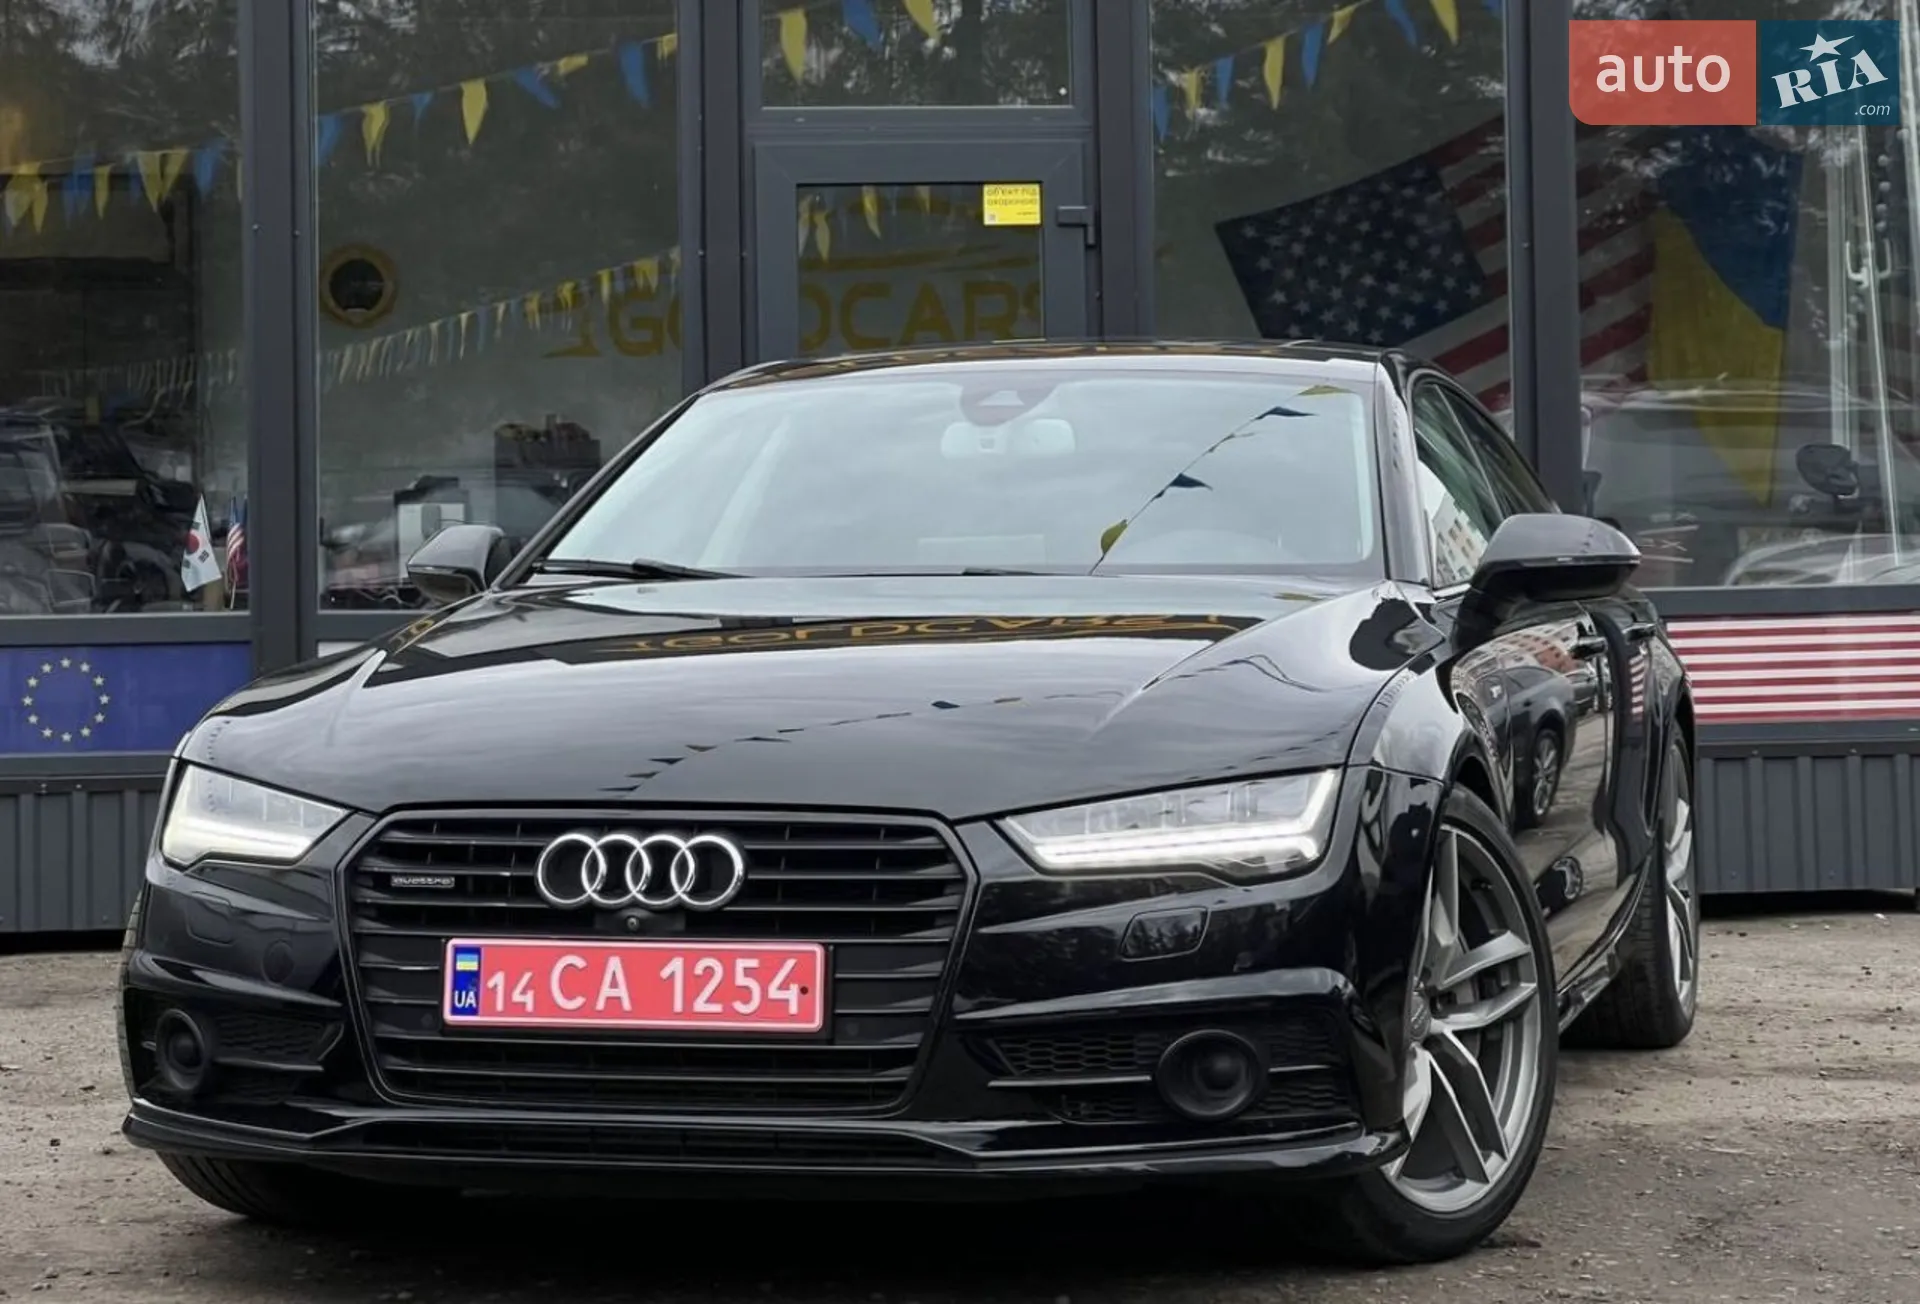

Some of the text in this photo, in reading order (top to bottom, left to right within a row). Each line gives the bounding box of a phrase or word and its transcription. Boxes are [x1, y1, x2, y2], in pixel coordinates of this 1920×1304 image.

[454, 990, 477, 1008] UA
[486, 954, 799, 1015] 14 CA 1254
